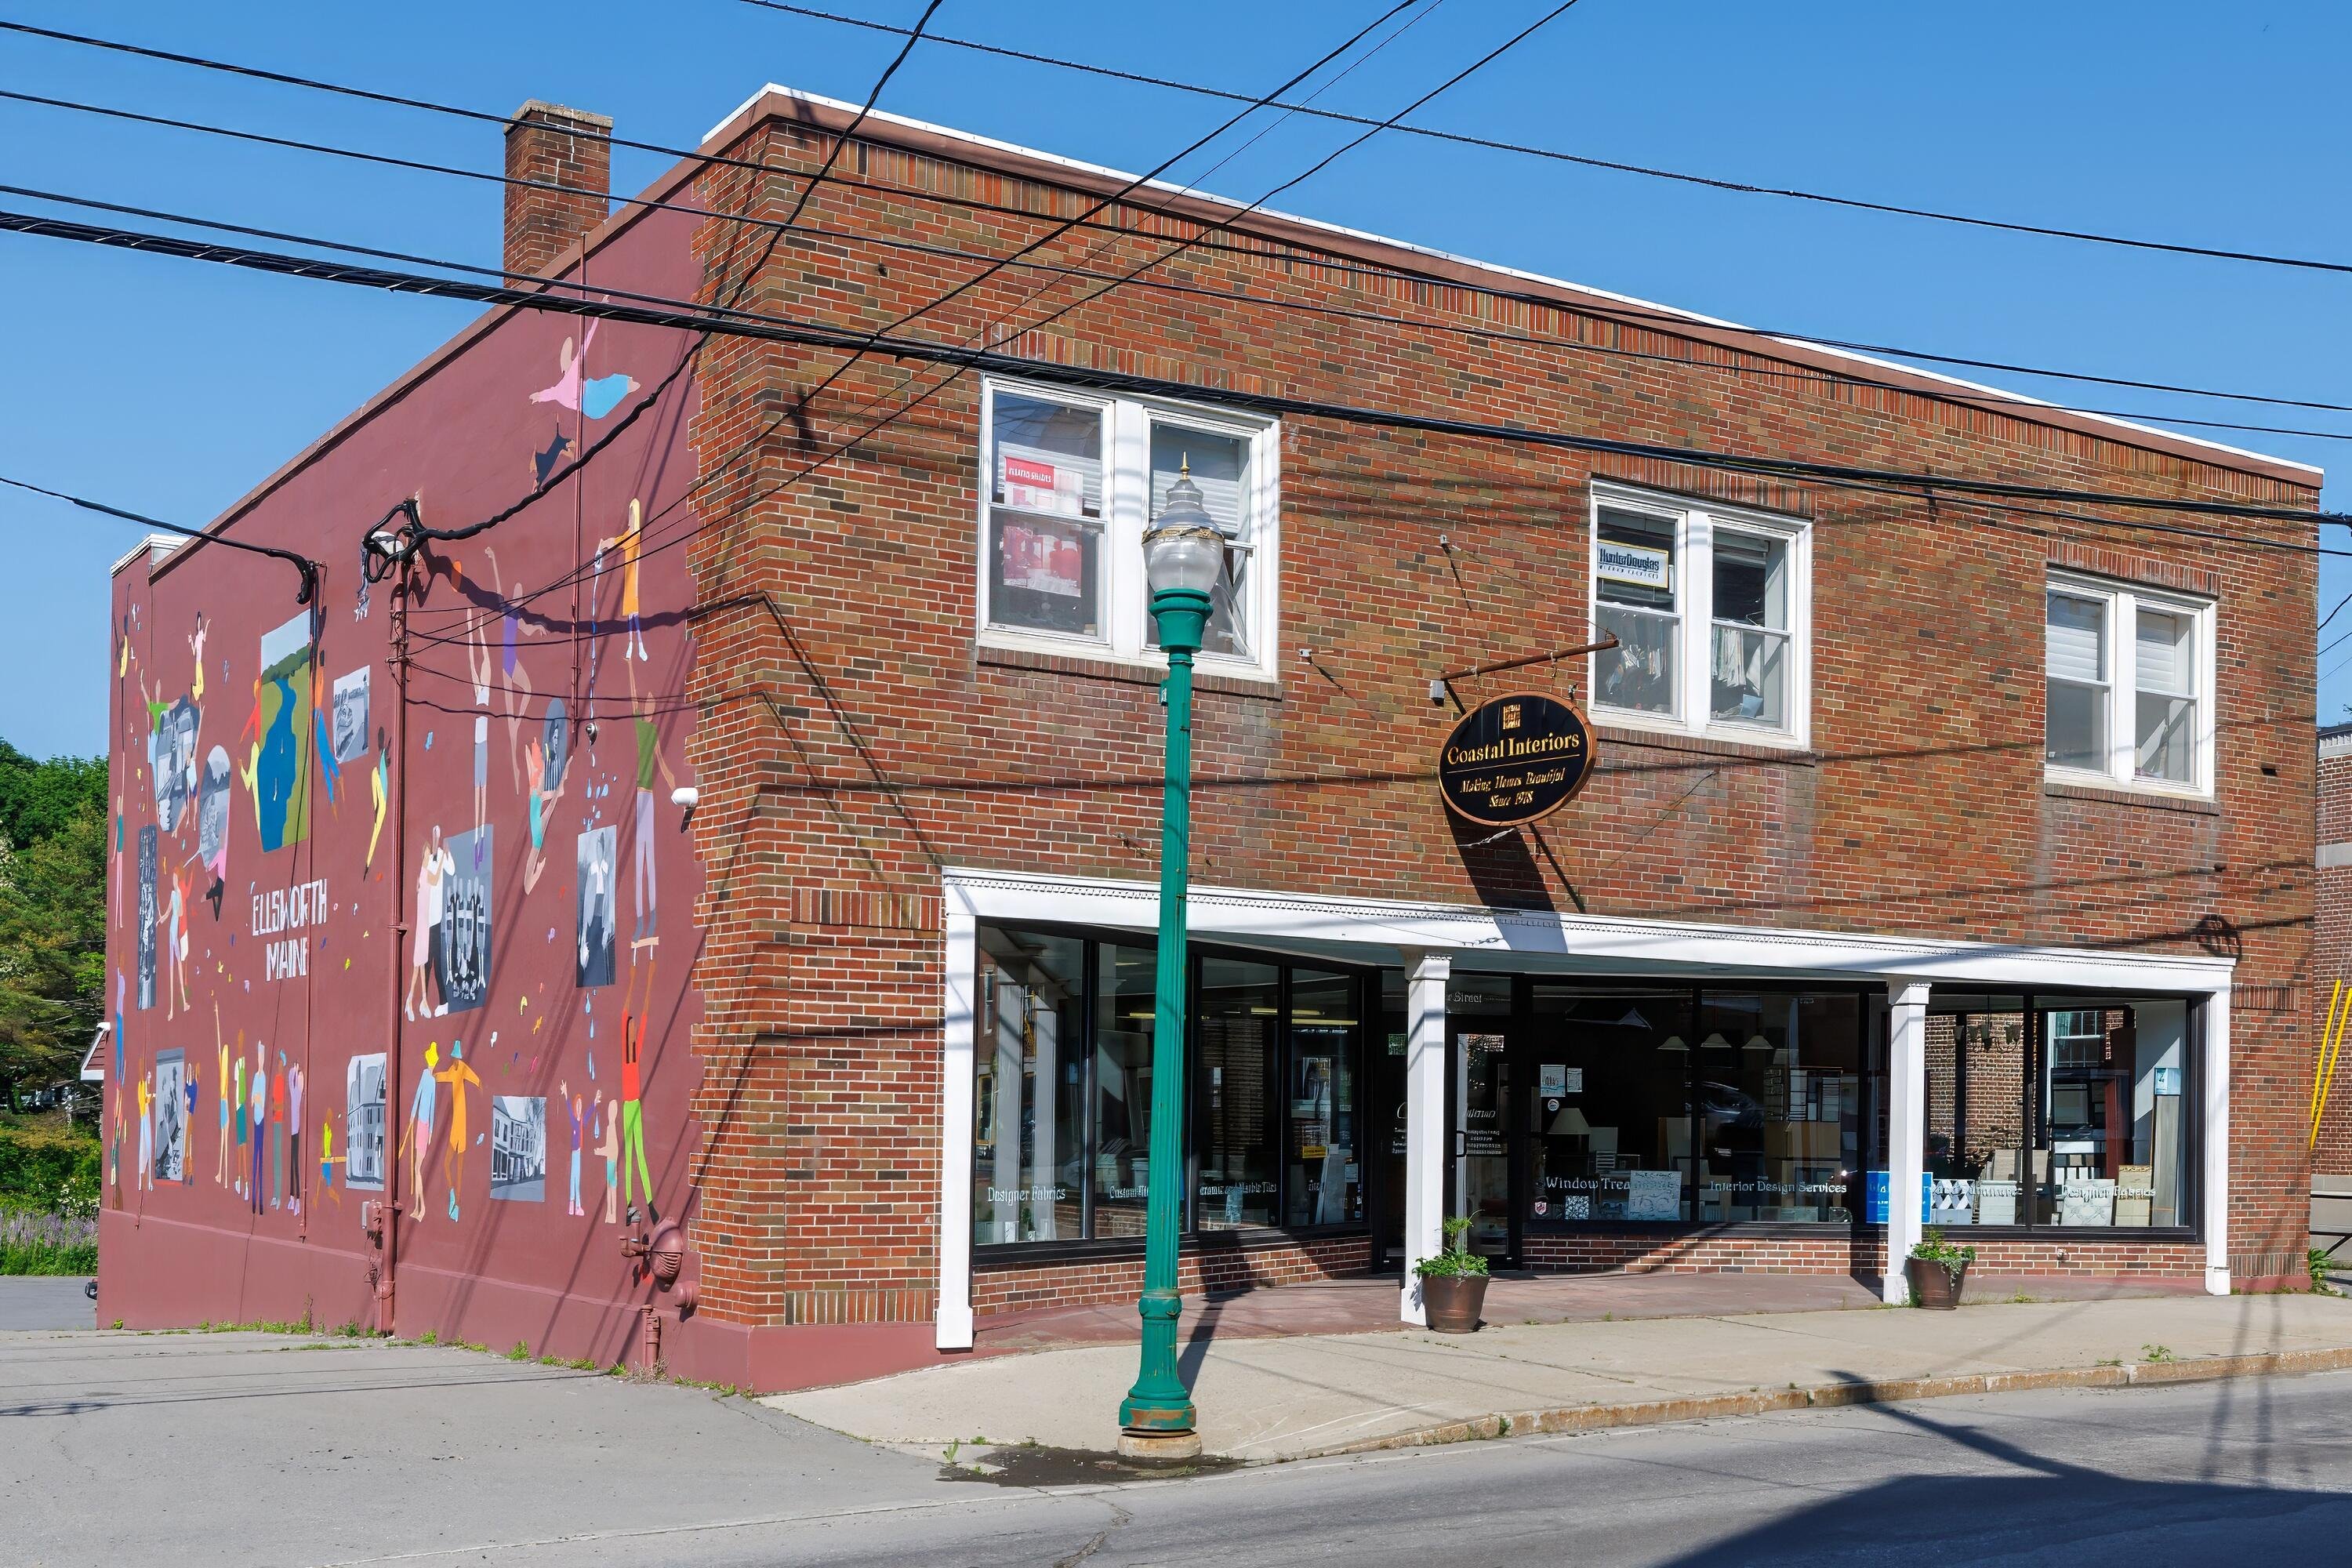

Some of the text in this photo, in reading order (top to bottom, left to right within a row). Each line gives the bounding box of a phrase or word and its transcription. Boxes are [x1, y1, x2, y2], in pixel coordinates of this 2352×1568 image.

[1447, 732, 1580, 765] Coastal Interiors
[1460, 768, 1566, 793] Making Homes Beautiful
[1490, 794, 1512, 808] Since
[252, 879, 327, 936] ELLSWORTH
[1545, 1177, 1599, 1189] Window
[1709, 1180, 1848, 1195] Interior Design Services
[987, 1185, 1067, 1207] Designer Fabrics
